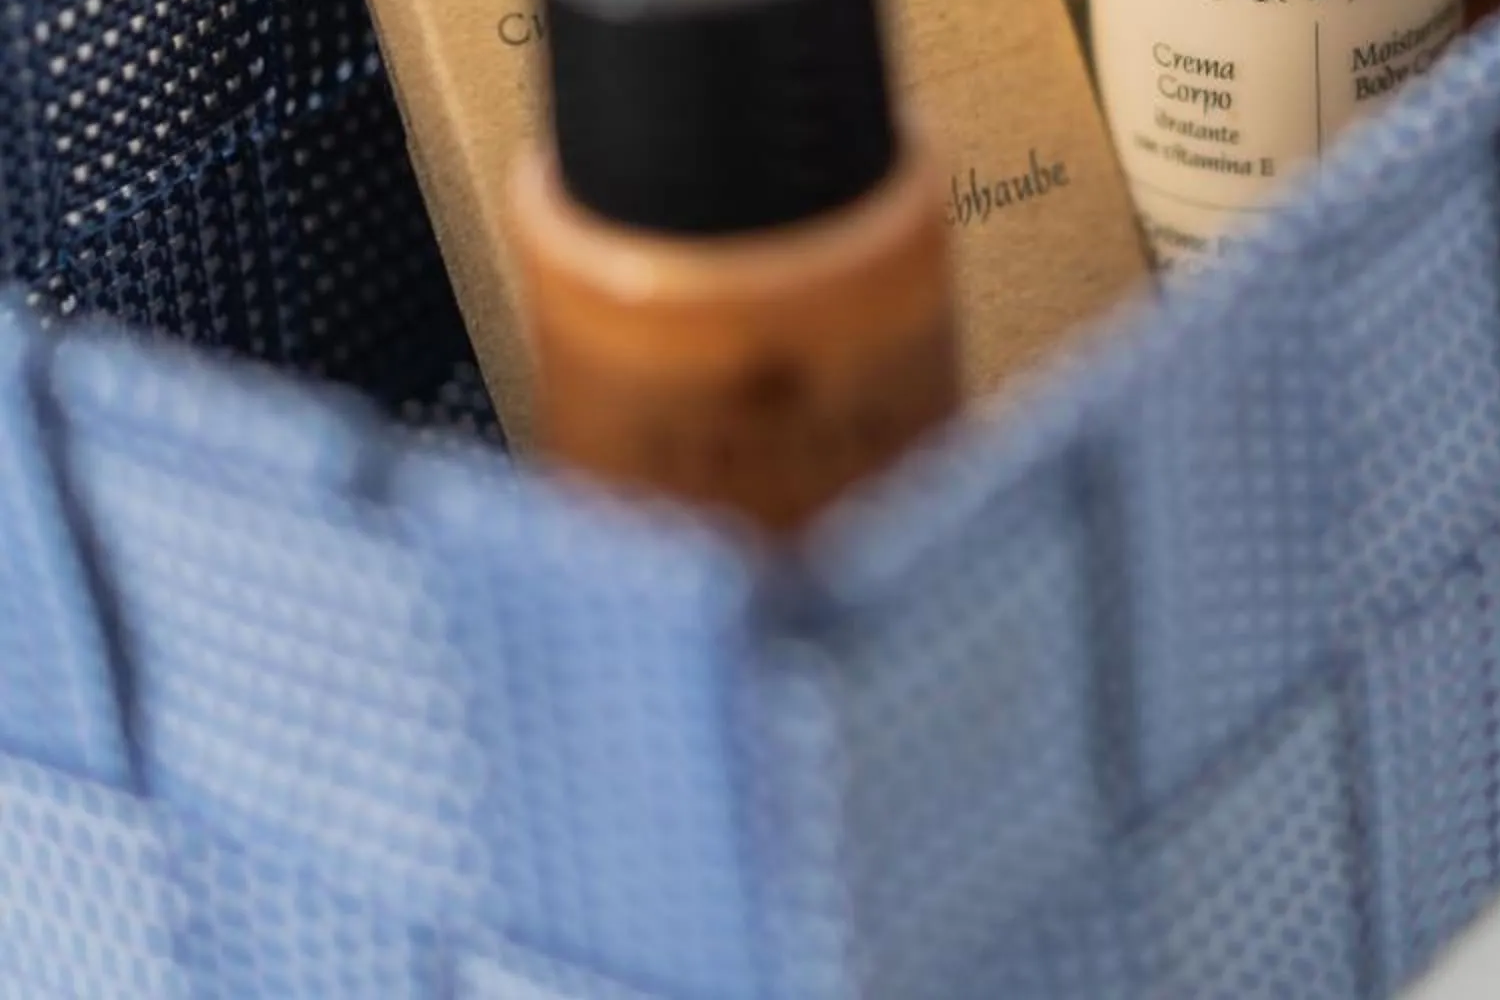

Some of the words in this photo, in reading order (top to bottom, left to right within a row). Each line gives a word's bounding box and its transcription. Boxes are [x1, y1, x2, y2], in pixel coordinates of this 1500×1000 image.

[1152, 41, 1235, 81] Crema
[1157, 73, 1233, 117] Corpo
[1259, 157, 1274, 176] E
